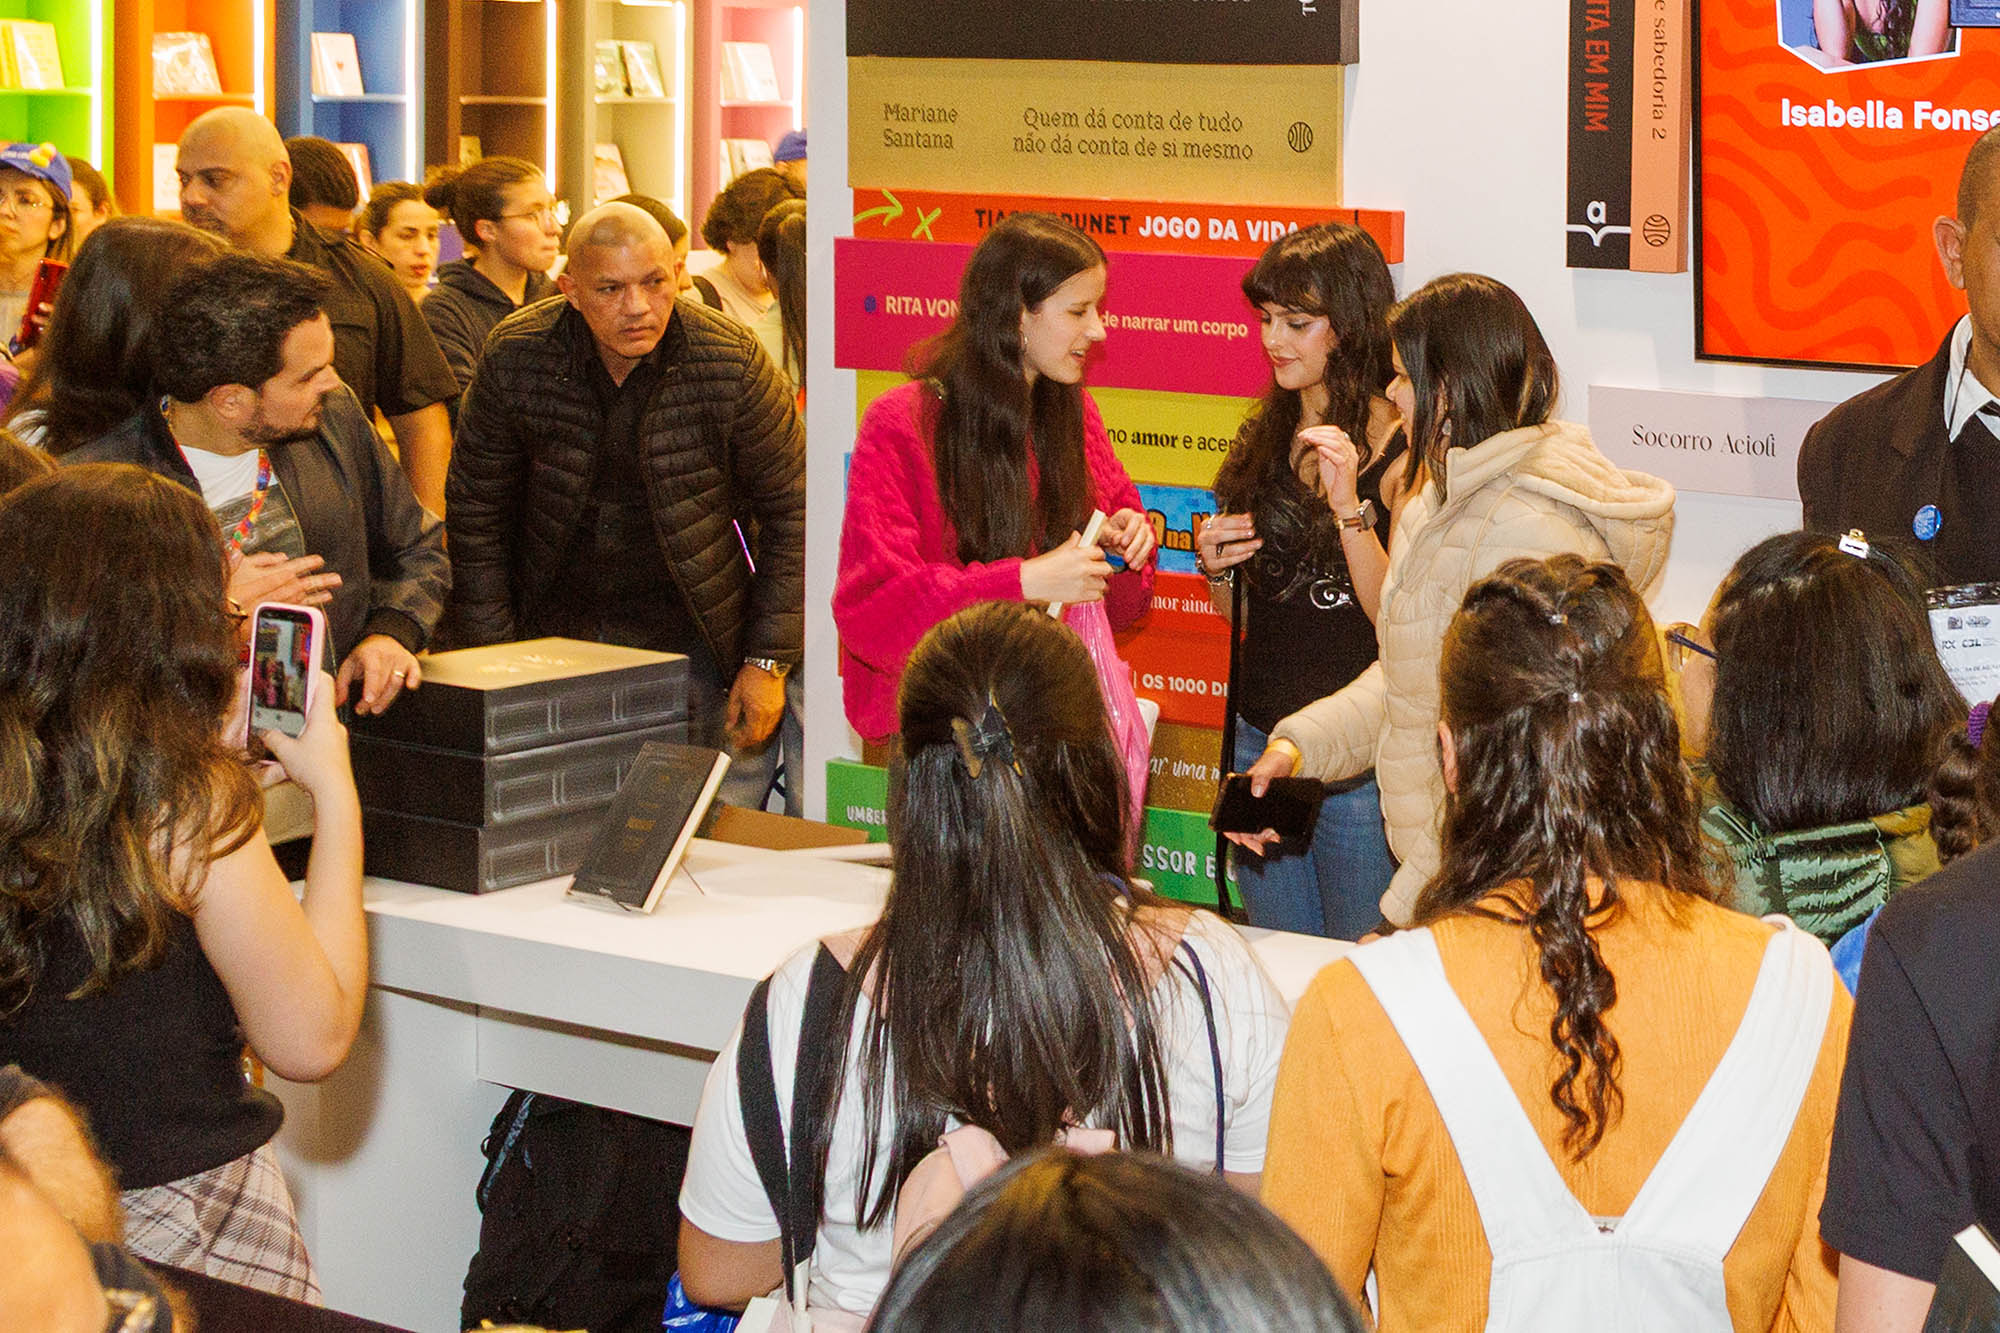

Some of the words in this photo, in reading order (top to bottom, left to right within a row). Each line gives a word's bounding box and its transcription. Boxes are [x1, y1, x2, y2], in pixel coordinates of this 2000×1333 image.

[1584, 40, 1610, 74] EM
[1652, 18, 1668, 120] sabedoria
[883, 103, 958, 123] Mariane
[1023, 107, 1079, 130] Quem
[1084, 107, 1106, 129] dá
[1111, 110, 1164, 130] conta
[1168, 110, 1193, 131] de
[1199, 111, 1243, 132] tudo
[1583, 81, 1610, 132] MIM
[1781, 98, 1903, 129] Isabella
[883, 128, 954, 149] Santana
[1012, 132, 1046, 153] não
[1050, 133, 1073, 153] dá
[1077, 136, 1130, 156] conta
[1134, 136, 1158, 157] de
[1162, 138, 1178, 158] si
[1182, 141, 1254, 160] mesmo
[1651, 127, 1667, 140] 2
[1138, 215, 1201, 240] JOGO
[1207, 218, 1239, 241] DA
[885, 295, 922, 316] RITA
[1121, 314, 1170, 332] narrar
[1173, 319, 1198, 334] um
[1201, 320, 1248, 340] corpo
[1131, 431, 1178, 449] amor
[1183, 434, 1193, 449] e
[1632, 423, 1713, 451] Socorro
[1142, 673, 1165, 691] OS
[1168, 676, 1207, 696] 1000
[1172, 758, 1206, 781] uma
[1142, 844, 1197, 877] SSOR
